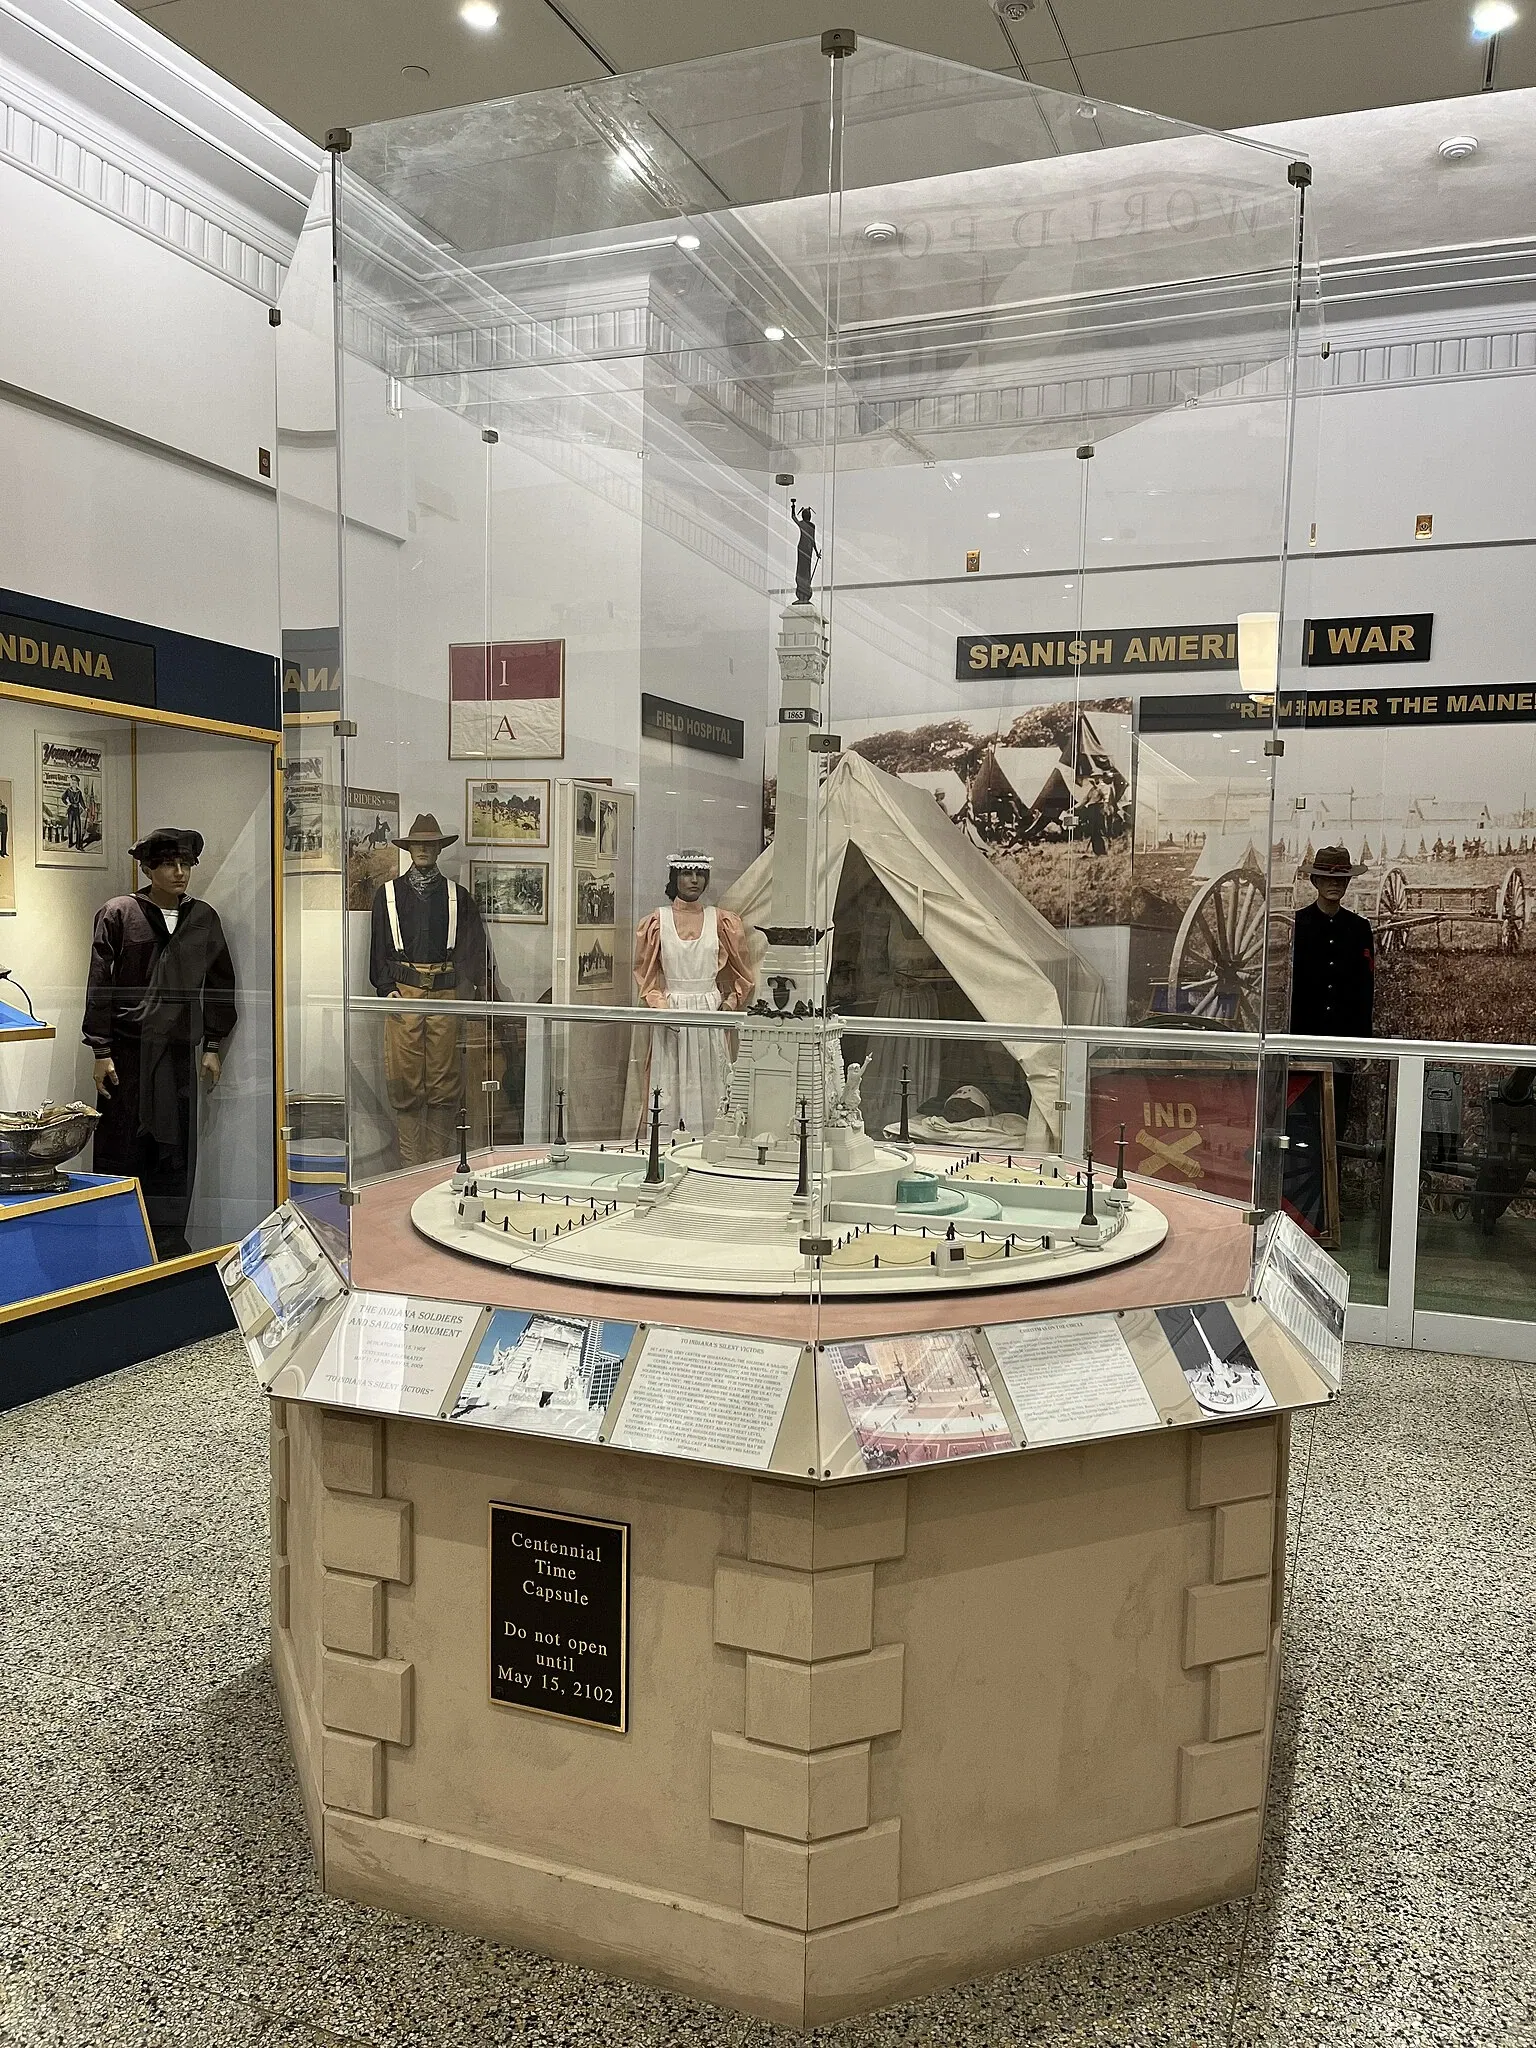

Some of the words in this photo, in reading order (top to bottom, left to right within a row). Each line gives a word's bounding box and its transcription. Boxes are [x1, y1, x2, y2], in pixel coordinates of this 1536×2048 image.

[968, 638, 1113, 670] SPANISH
[1327, 624, 1416, 655] WAR
[788, 711, 803, 719] 1865
[1386, 696, 1438, 714] THE
[1446, 692, 1536, 713] MAINE
[492, 715, 517, 741] A
[656, 710, 684, 732] FIELD
[686, 718, 732, 745] HOSPITAL
[353, 793, 381, 806] RIDERS
[1143, 1101, 1197, 1129] IND
[358, 1304, 377, 1314] THE
[418, 1311, 463, 1324] SOLDIERS
[349, 1317, 368, 1326] AND
[410, 1324, 461, 1337] MONUMENT
[688, 1339, 718, 1347] INDIANA'S
[511, 1532, 601, 1562] Centennial
[534, 1559, 577, 1580] Time
[522, 1580, 589, 1606] Capsule
[504, 1621, 527, 1639] Do
[534, 1630, 560, 1646] not
[568, 1637, 608, 1657] open
[536, 1653, 574, 1673] until
[498, 1665, 532, 1689] May
[541, 1674, 565, 1696] 15,
[573, 1681, 614, 1704] 2102
